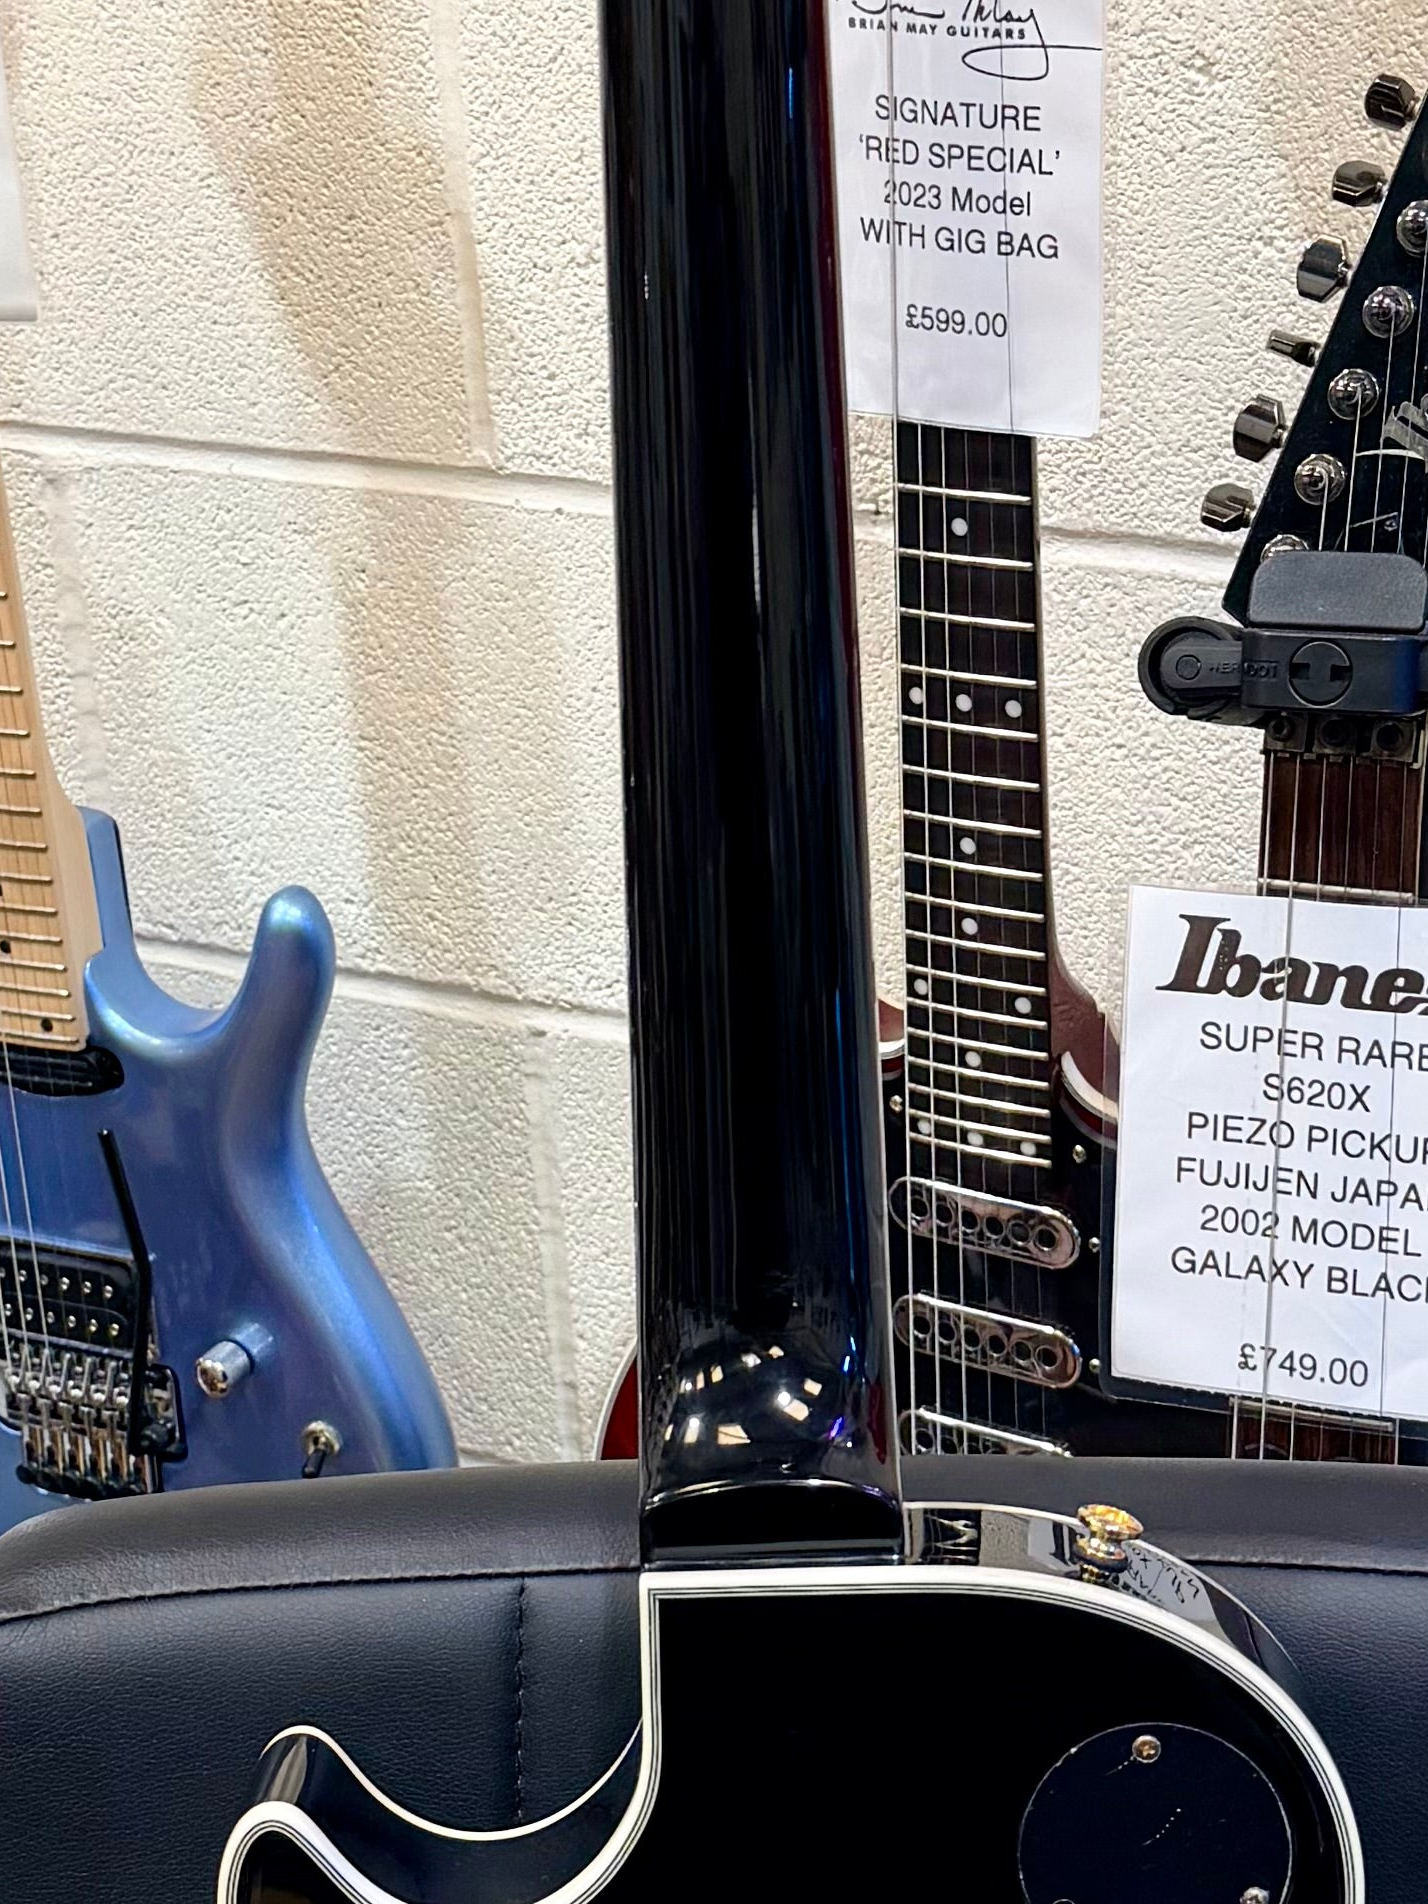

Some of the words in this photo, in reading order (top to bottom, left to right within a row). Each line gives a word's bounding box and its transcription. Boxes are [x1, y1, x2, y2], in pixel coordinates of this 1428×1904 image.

[848, 17, 898, 32] BRIAN
[905, 22, 937, 36] MAY
[946, 26, 1026, 40] GUITARS
[874, 95, 1041, 131] SIGNATURE
[883, 181, 942, 210] 2023
[951, 187, 1031, 216] Model
[860, 217, 925, 249] WITH
[934, 225, 985, 255] GIG
[998, 230, 1059, 259] BAG
[905, 304, 1008, 337] £599.00
[1199, 1021, 1324, 1061] SUPER
[1262, 1073, 1372, 1113] S620X
[1187, 1112, 1295, 1149] PIEZO
[1176, 1157, 1318, 1199] FUJIJEN
[1200, 1205, 1280, 1240] 2002
[1291, 1217, 1423, 1257] MODEL
[1171, 1246, 1315, 1290] GALAXY
[1237, 1344, 1369, 1387] £749.00
